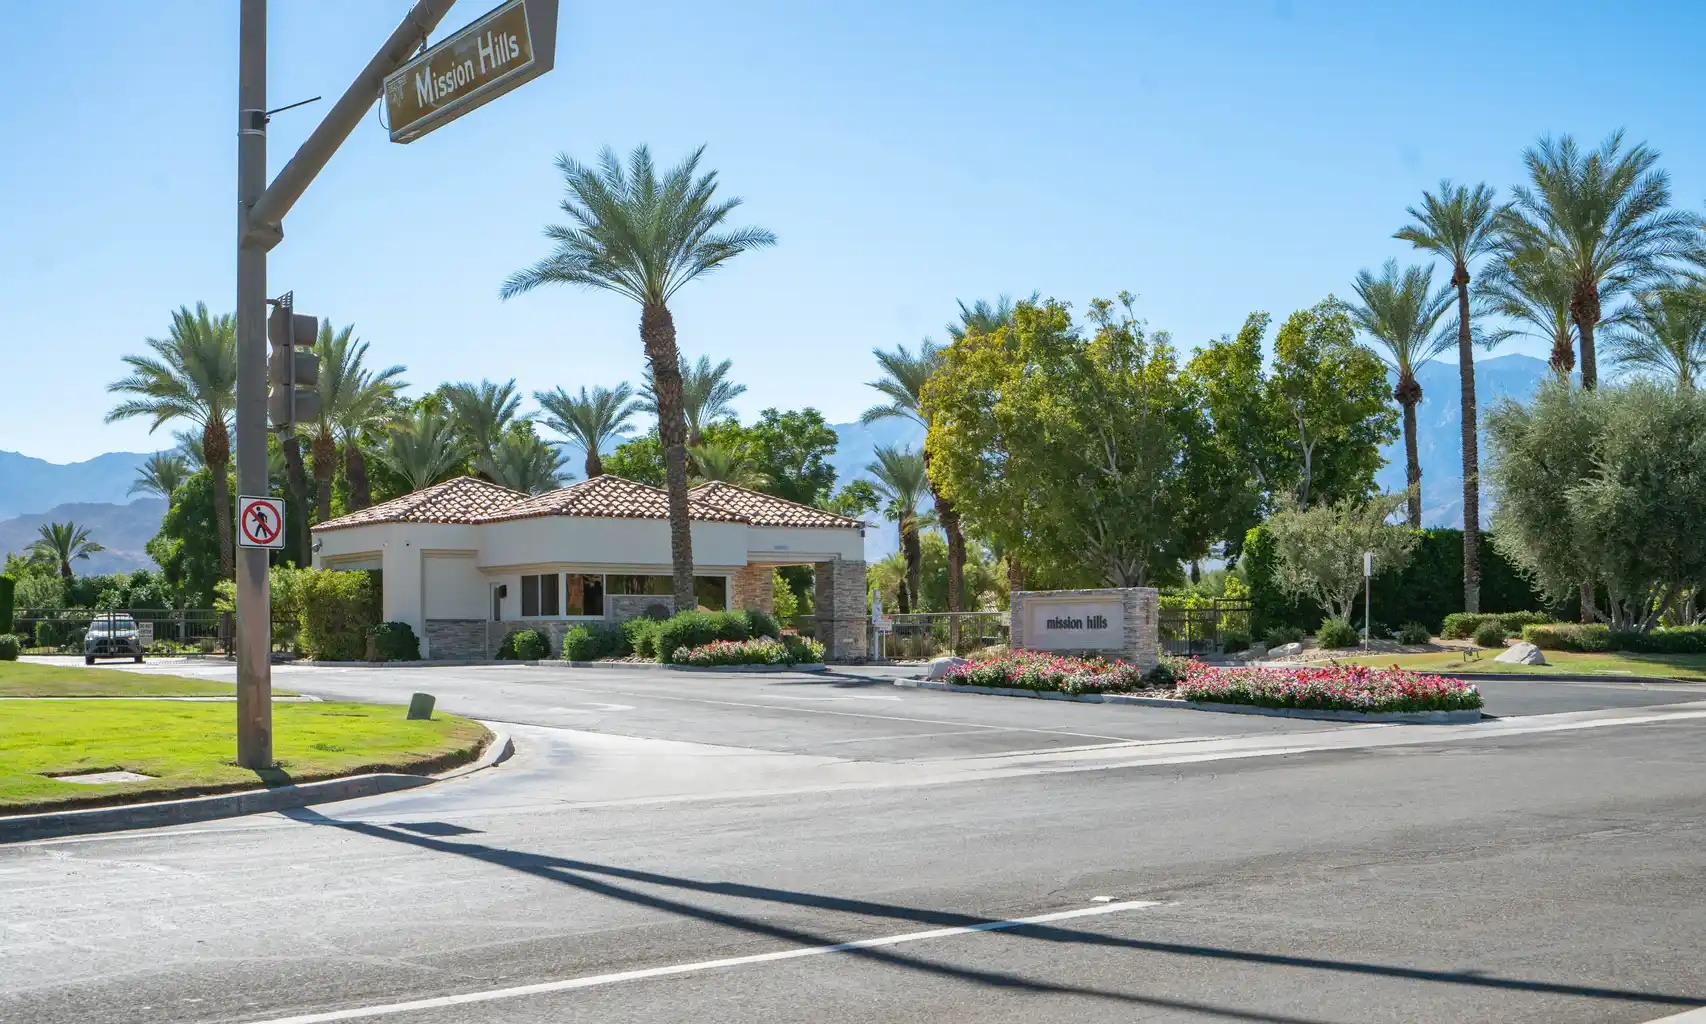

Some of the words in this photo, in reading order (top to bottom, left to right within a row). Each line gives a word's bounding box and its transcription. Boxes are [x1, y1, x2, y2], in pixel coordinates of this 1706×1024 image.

[416, 59, 475, 108] Mission
[477, 30, 519, 75] Hills
[1046, 616, 1083, 630] mission
[1086, 615, 1108, 629] hills
